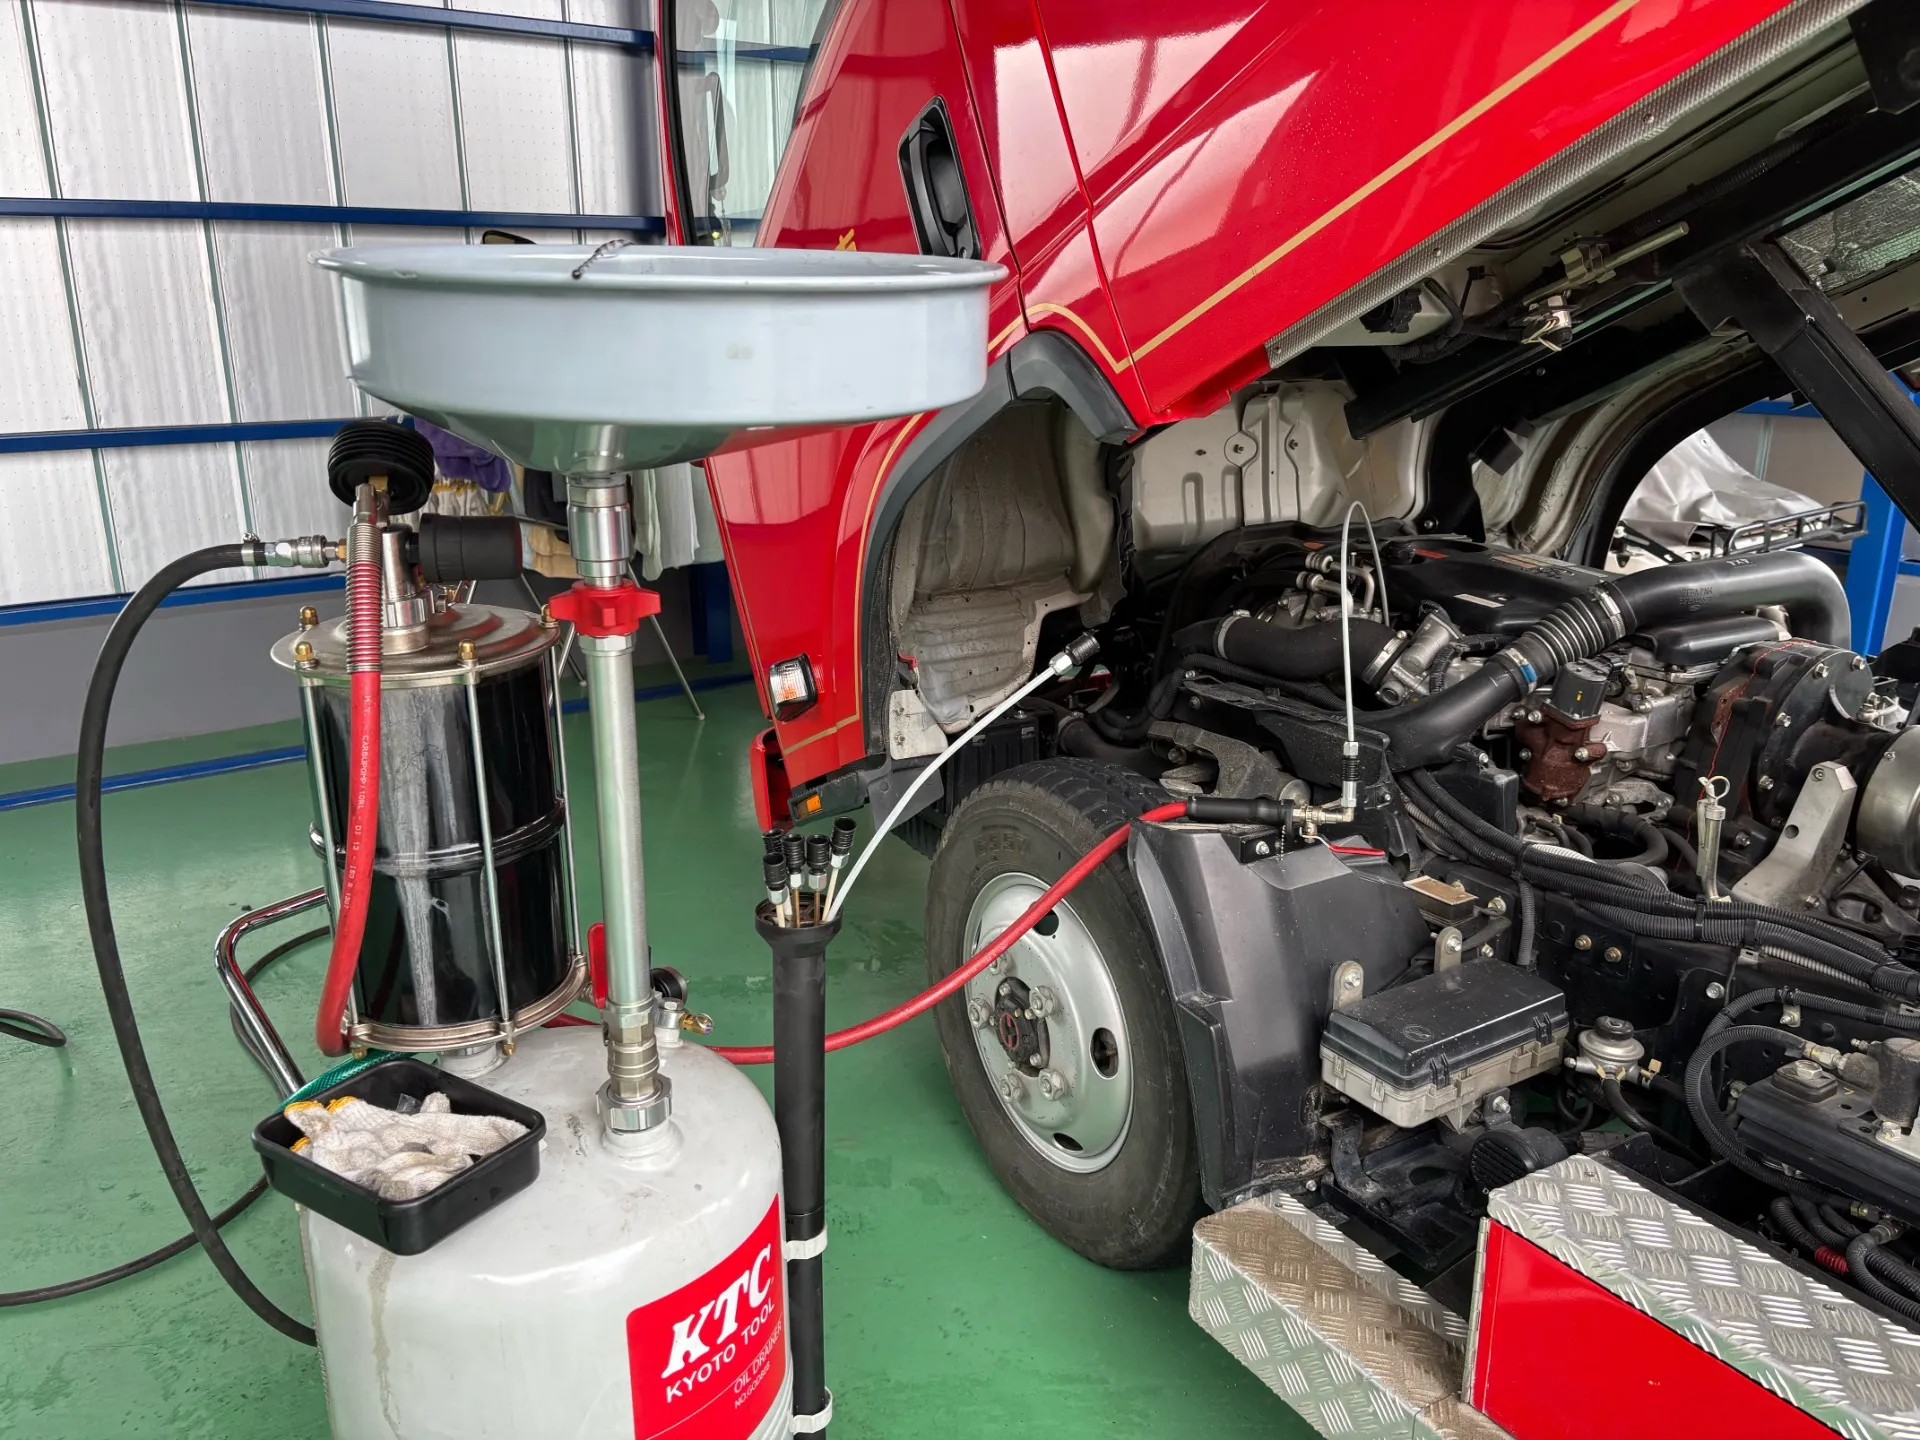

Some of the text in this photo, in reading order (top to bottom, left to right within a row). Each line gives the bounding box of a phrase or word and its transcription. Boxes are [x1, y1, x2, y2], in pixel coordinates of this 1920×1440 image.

[344, 892, 352, 909] 1307
[349, 865, 357, 879] ISO
[661, 1243, 771, 1379] KTC
[665, 1302, 775, 1403] KYOTO TOOL
[734, 1320, 782, 1393] OIL DRAINER
